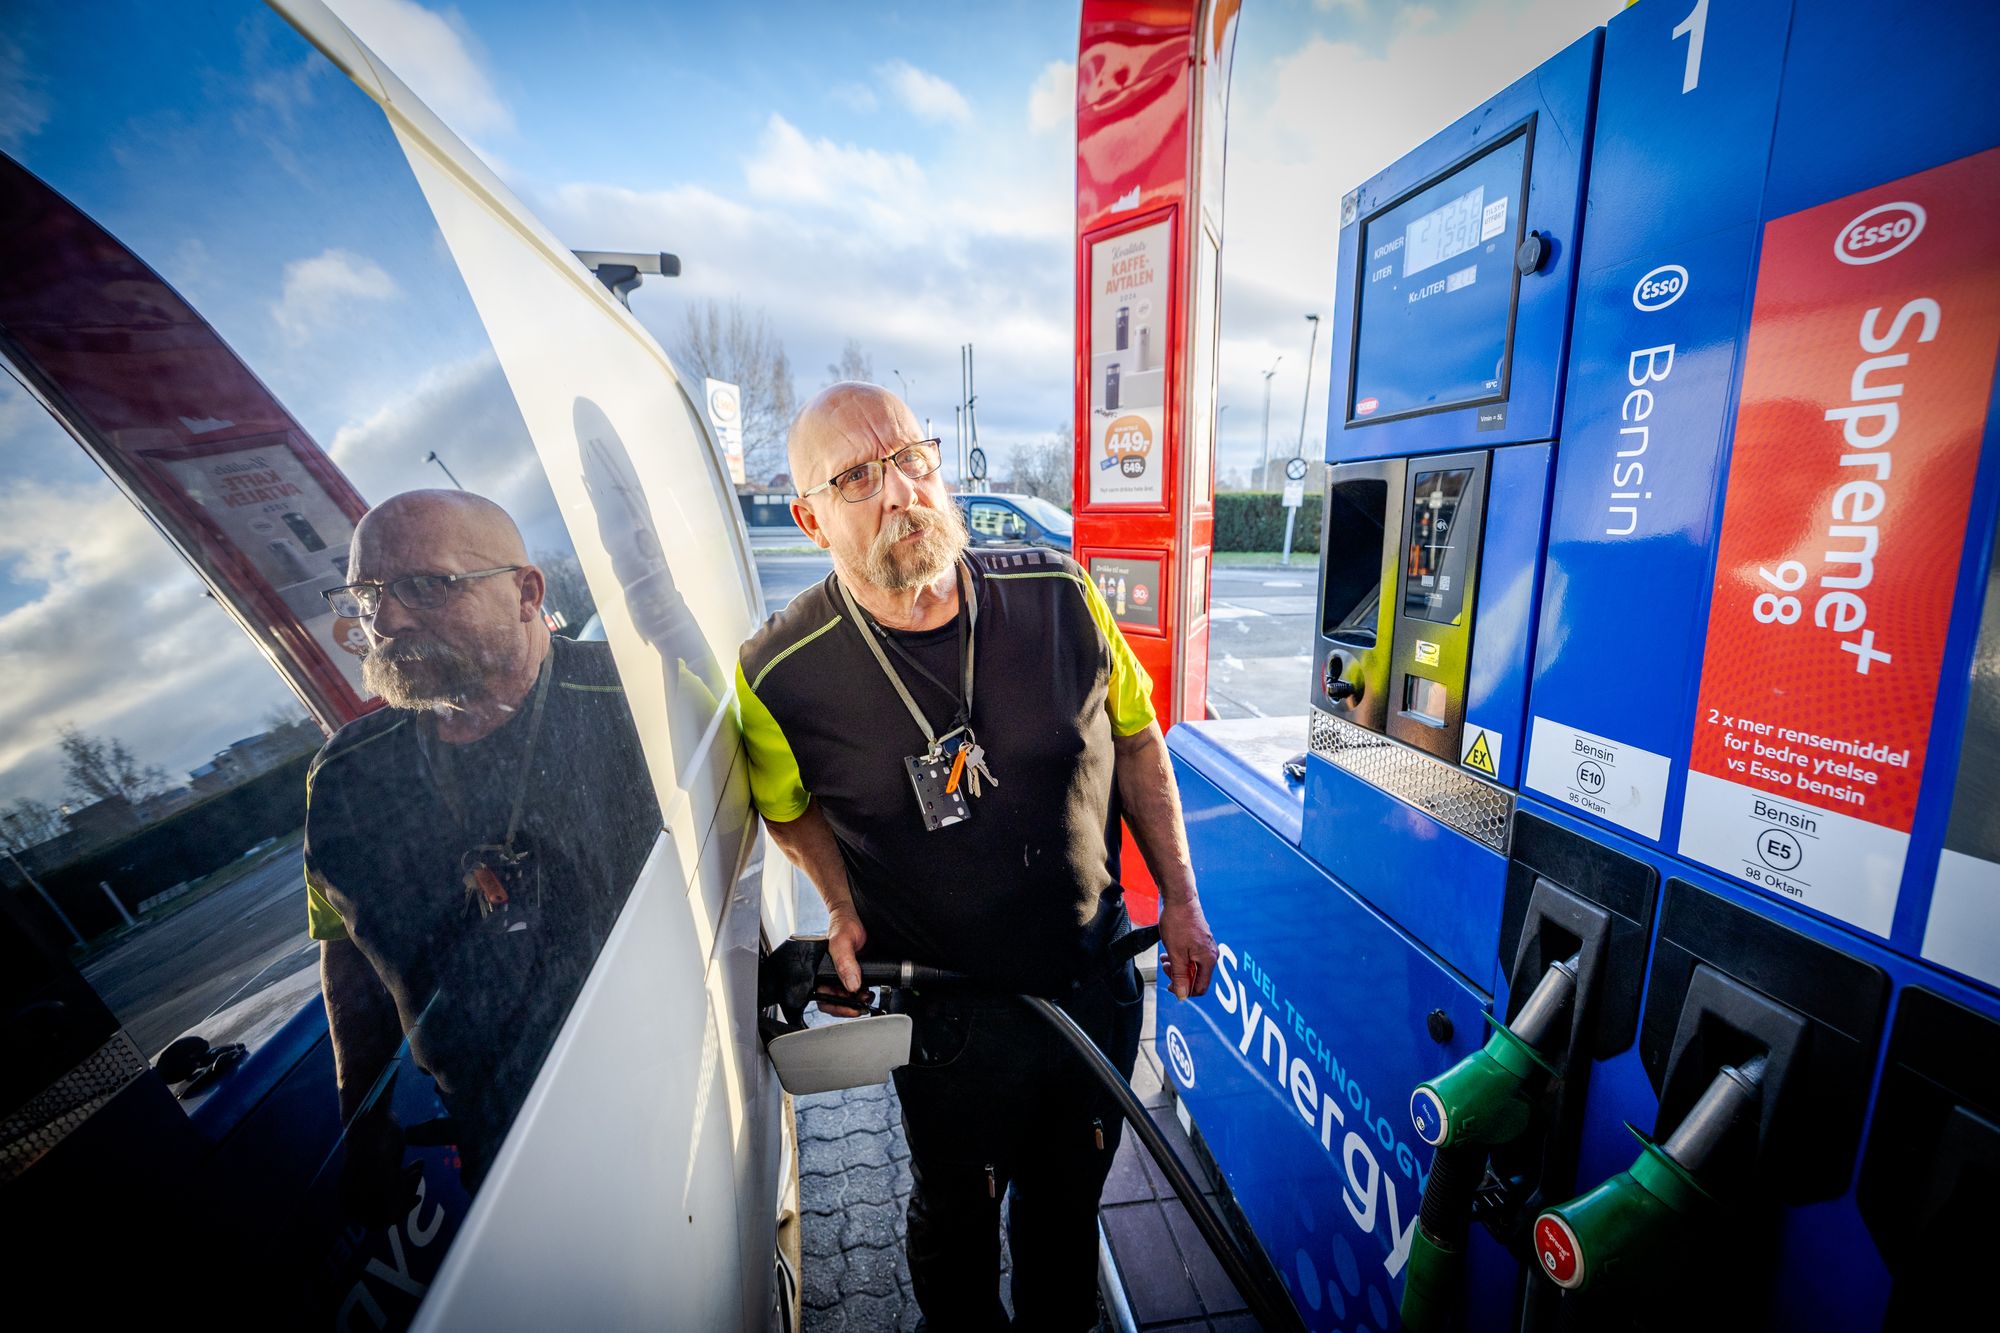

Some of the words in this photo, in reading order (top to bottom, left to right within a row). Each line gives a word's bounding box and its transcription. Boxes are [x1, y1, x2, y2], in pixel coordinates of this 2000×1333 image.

[1672, 0, 1707, 94] 1
[1484, 211, 1504, 225] UTFØRT
[1485, 202, 1505, 217] TILSYN
[1374, 236, 1404, 260] KRONER
[1847, 217, 1912, 251] Esso
[1111, 254, 1150, 278] KAFFE-
[1372, 265, 1392, 283] LITER
[1105, 268, 1153, 295] AVTALEN
[1641, 276, 1680, 301] Esso
[1485, 381, 1498, 389] 15°C
[1606, 343, 1675, 536] Bensin
[1814, 297, 1941, 675] Supreme+
[1752, 560, 1807, 625] 98
[1574, 738, 1614, 763] Bensin
[1707, 709, 1718, 724] 2
[1722, 715, 1734, 728] x
[1737, 719, 1774, 737] mer
[1778, 725, 1910, 768] rensemiddel
[1472, 750, 1486, 766] EX
[1723, 733, 1749, 751] for
[1753, 737, 1809, 768] bedre
[1813, 757, 1878, 785] ytelse
[1580, 769, 1602, 787] E10
[1727, 757, 1746, 772] vs
[1749, 760, 1792, 784] Esso
[1797, 772, 1865, 806] bensin
[1568, 792, 1580, 803] 95
[1582, 797, 1607, 815] Oktan
[1753, 800, 1817, 834] Bensin
[1767, 838, 1791, 860] E5
[1745, 866, 1762, 881] 98
[1764, 873, 1804, 898] Oktan
[1169, 1037, 1191, 1078] Esso
[1243, 951, 1279, 1011] FUEL
[1284, 998, 1430, 1199] TECHNOLOGY
[1215, 942, 1418, 1279] Synergy
